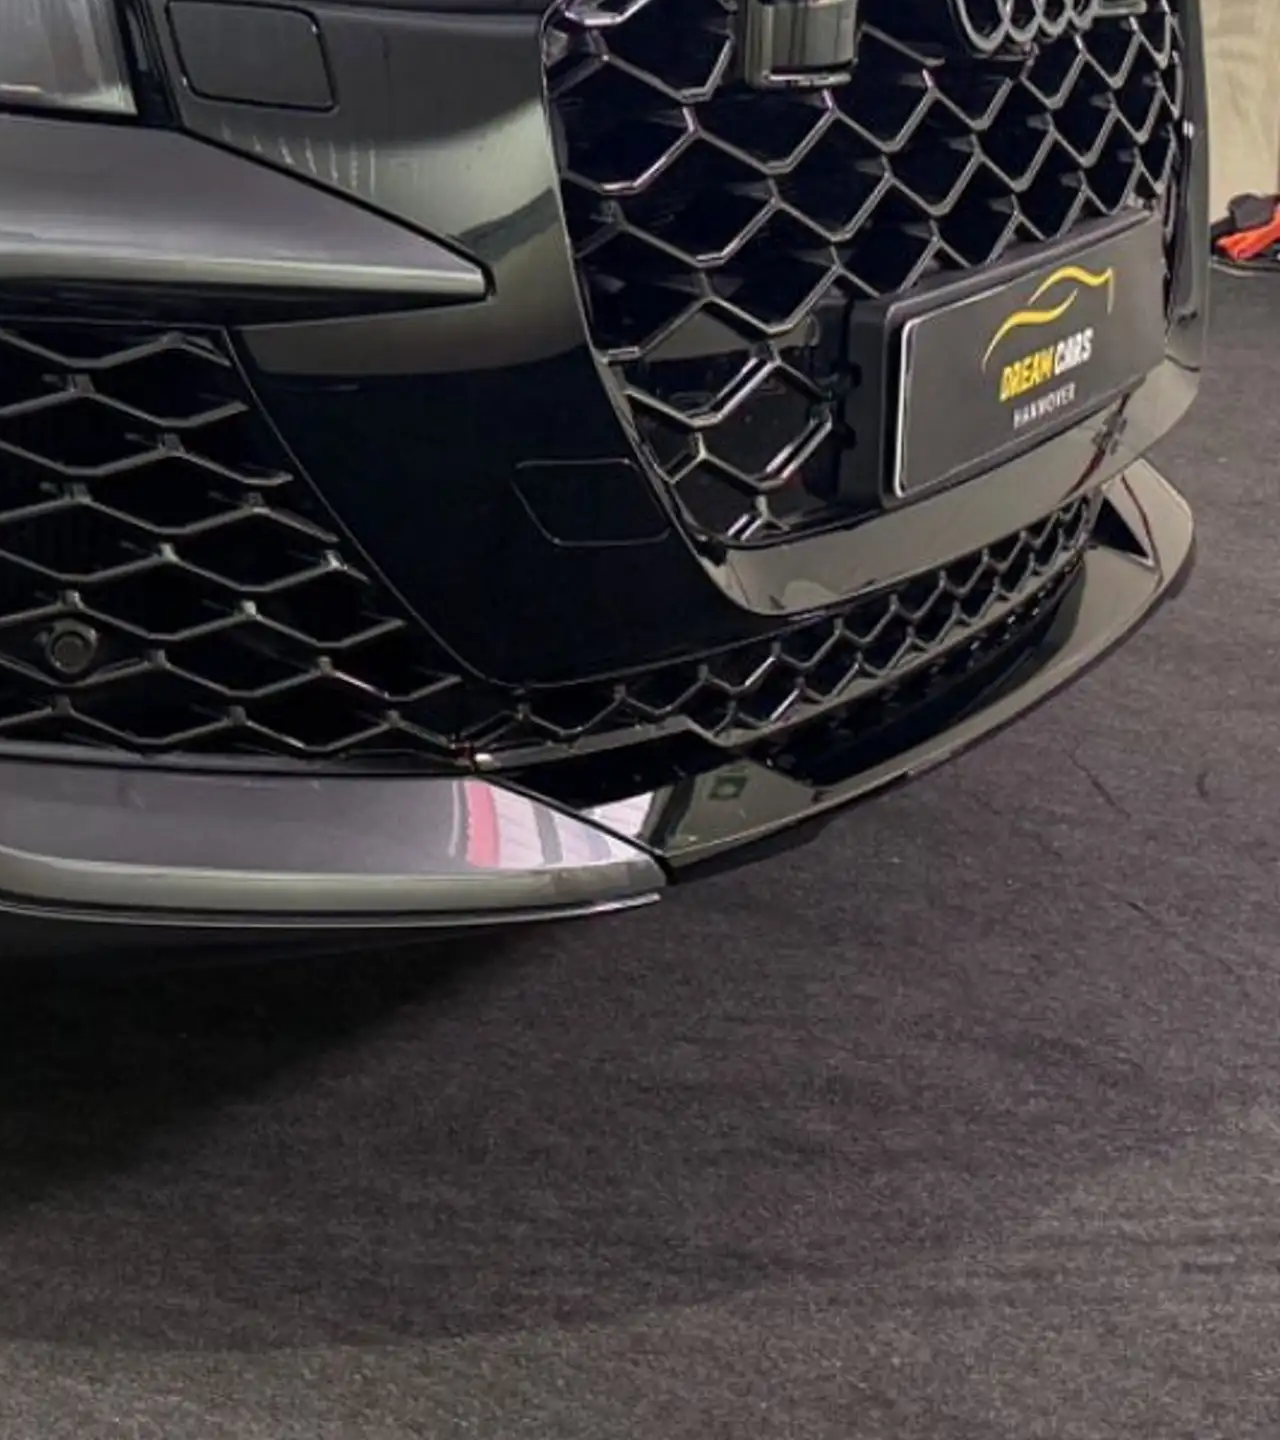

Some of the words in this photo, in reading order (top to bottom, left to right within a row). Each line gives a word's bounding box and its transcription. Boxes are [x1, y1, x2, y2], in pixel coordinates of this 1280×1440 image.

[999, 345, 1055, 402] DREAM
[1054, 327, 1094, 375] CARS
[1013, 383, 1076, 429] HANNOVER
